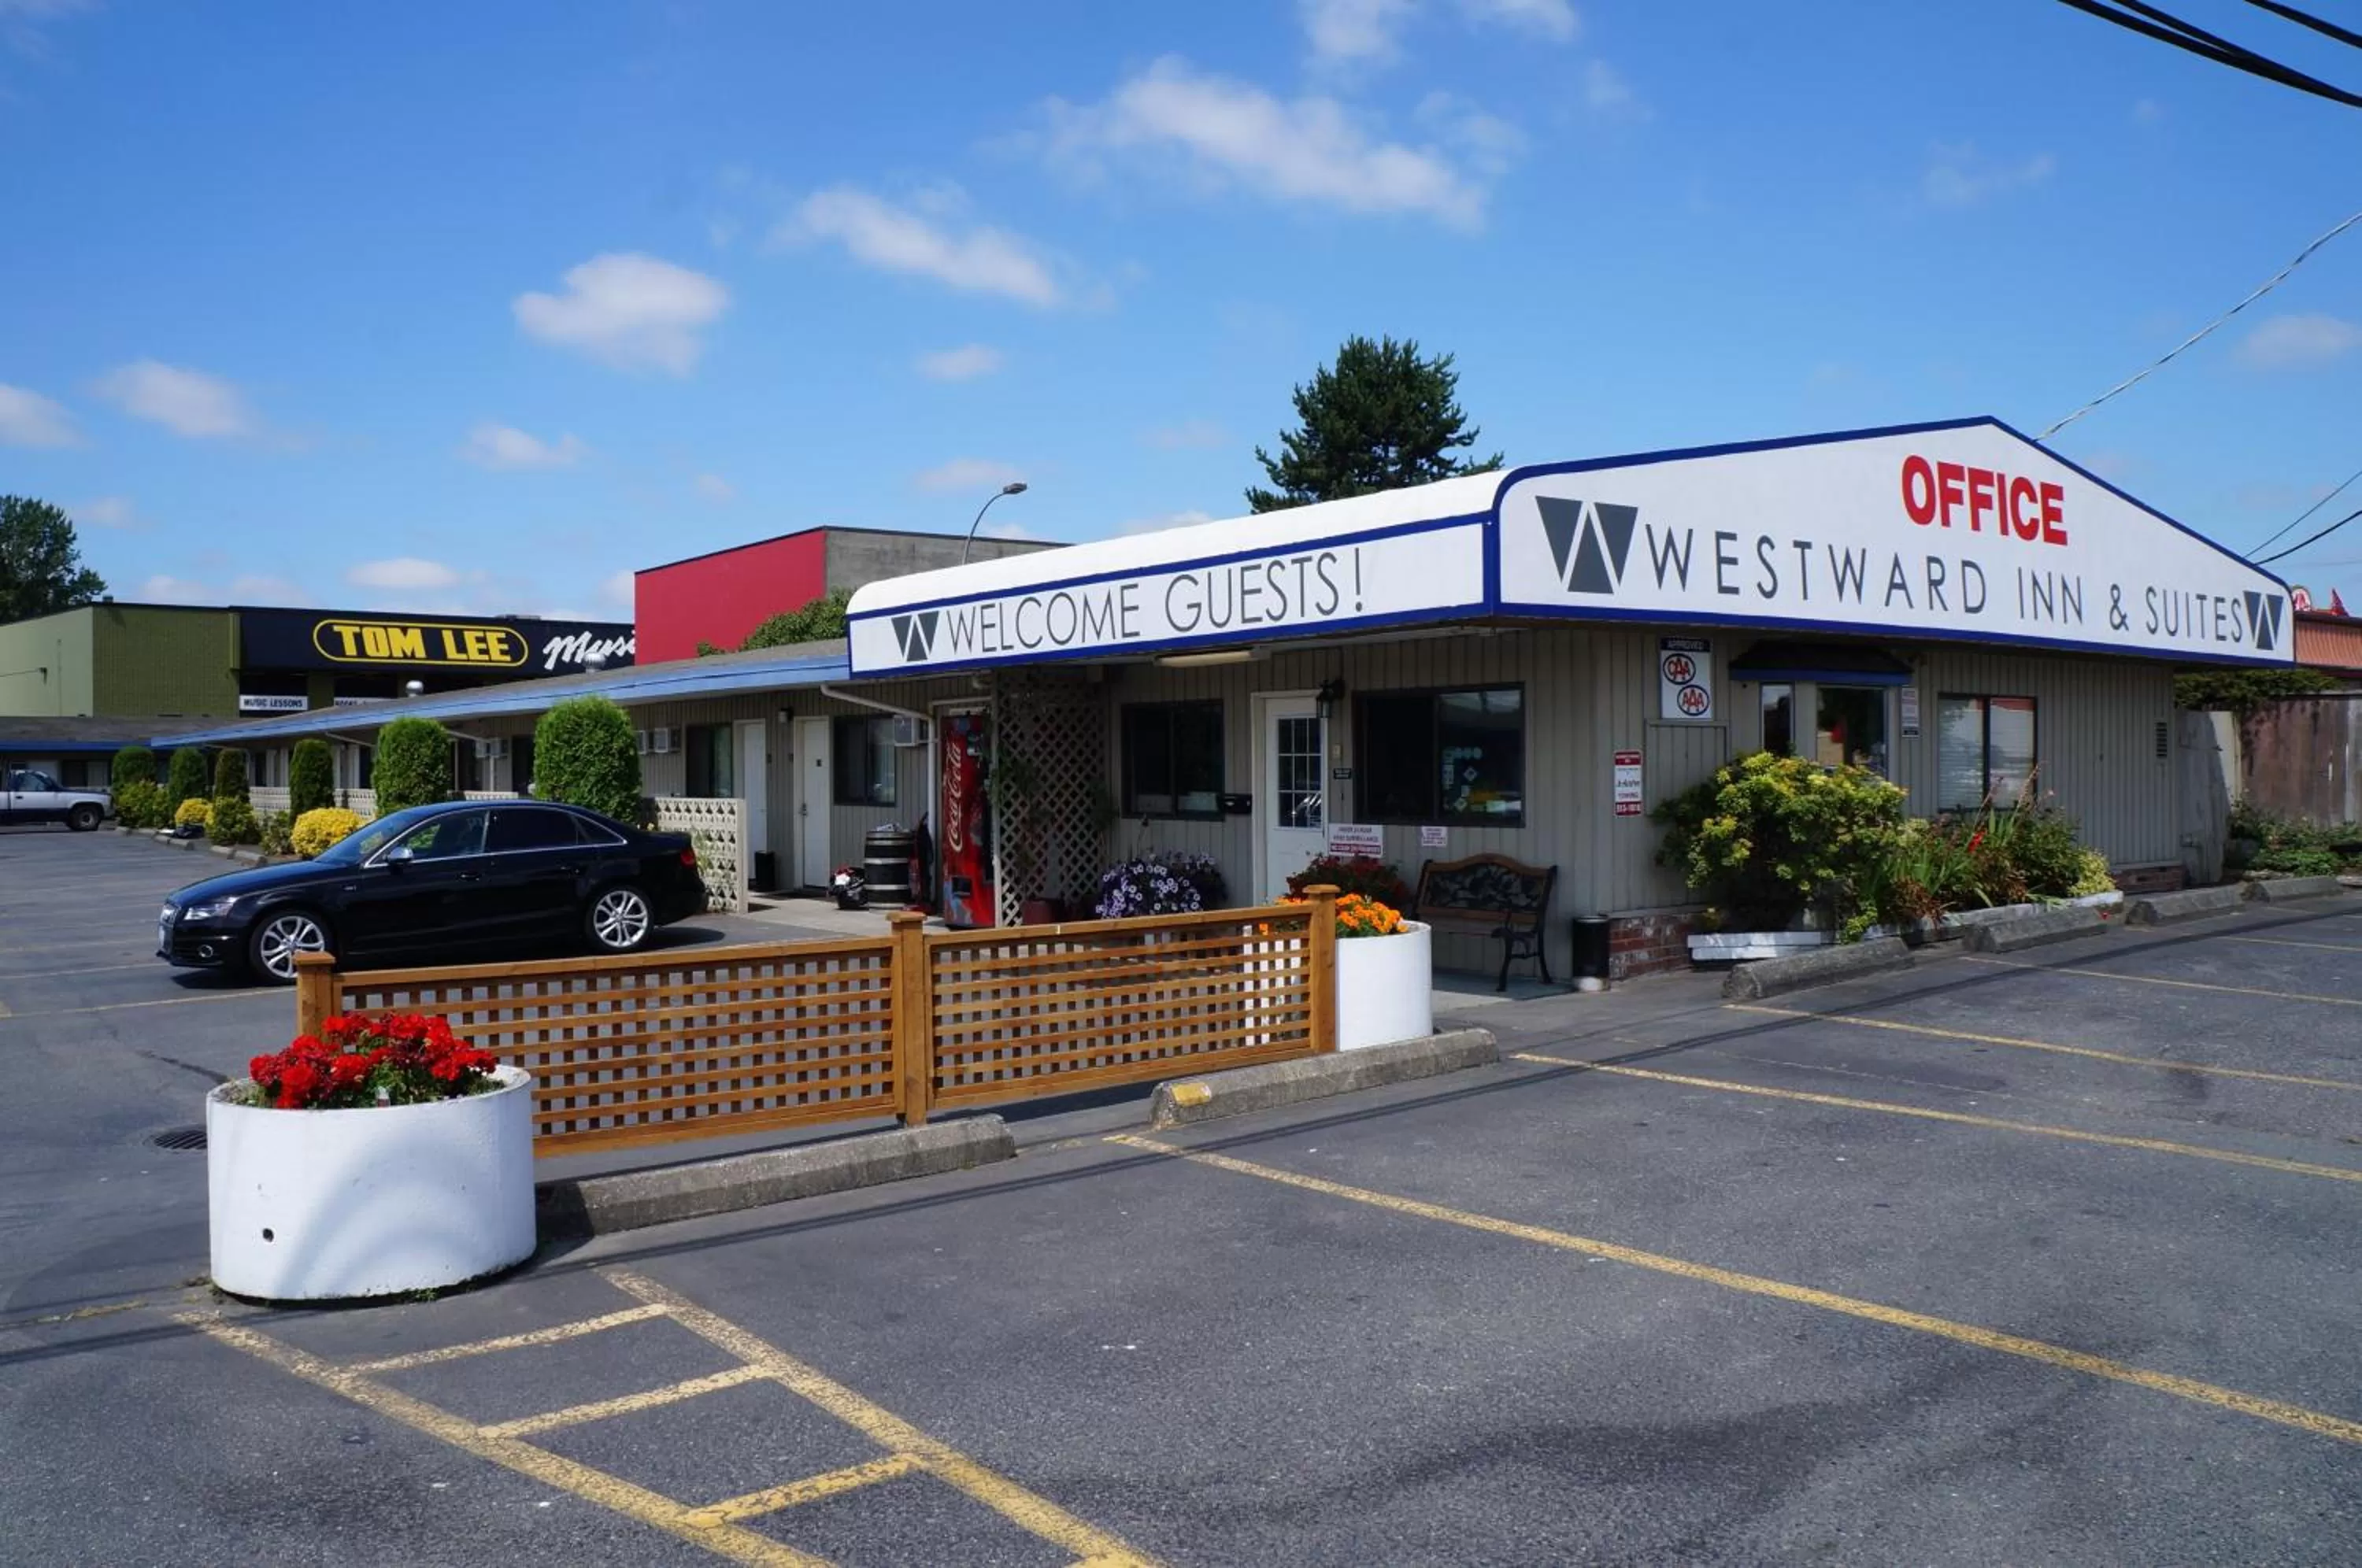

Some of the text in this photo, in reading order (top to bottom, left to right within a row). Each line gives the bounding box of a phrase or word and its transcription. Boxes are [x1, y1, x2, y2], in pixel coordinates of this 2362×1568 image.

[1901, 454, 2068, 545] OFFICE
[946, 583, 1140, 653] WELCOME
[1164, 547, 1364, 633] GUESTS!
[1645, 523, 1987, 615] WESTWARD
[2016, 566, 2082, 625] INN
[2109, 584, 2129, 631] &
[2145, 586, 2243, 642] SUITES
[333, 625, 511, 662] TOM LEE
[269, 698, 302, 708] LESSONS
